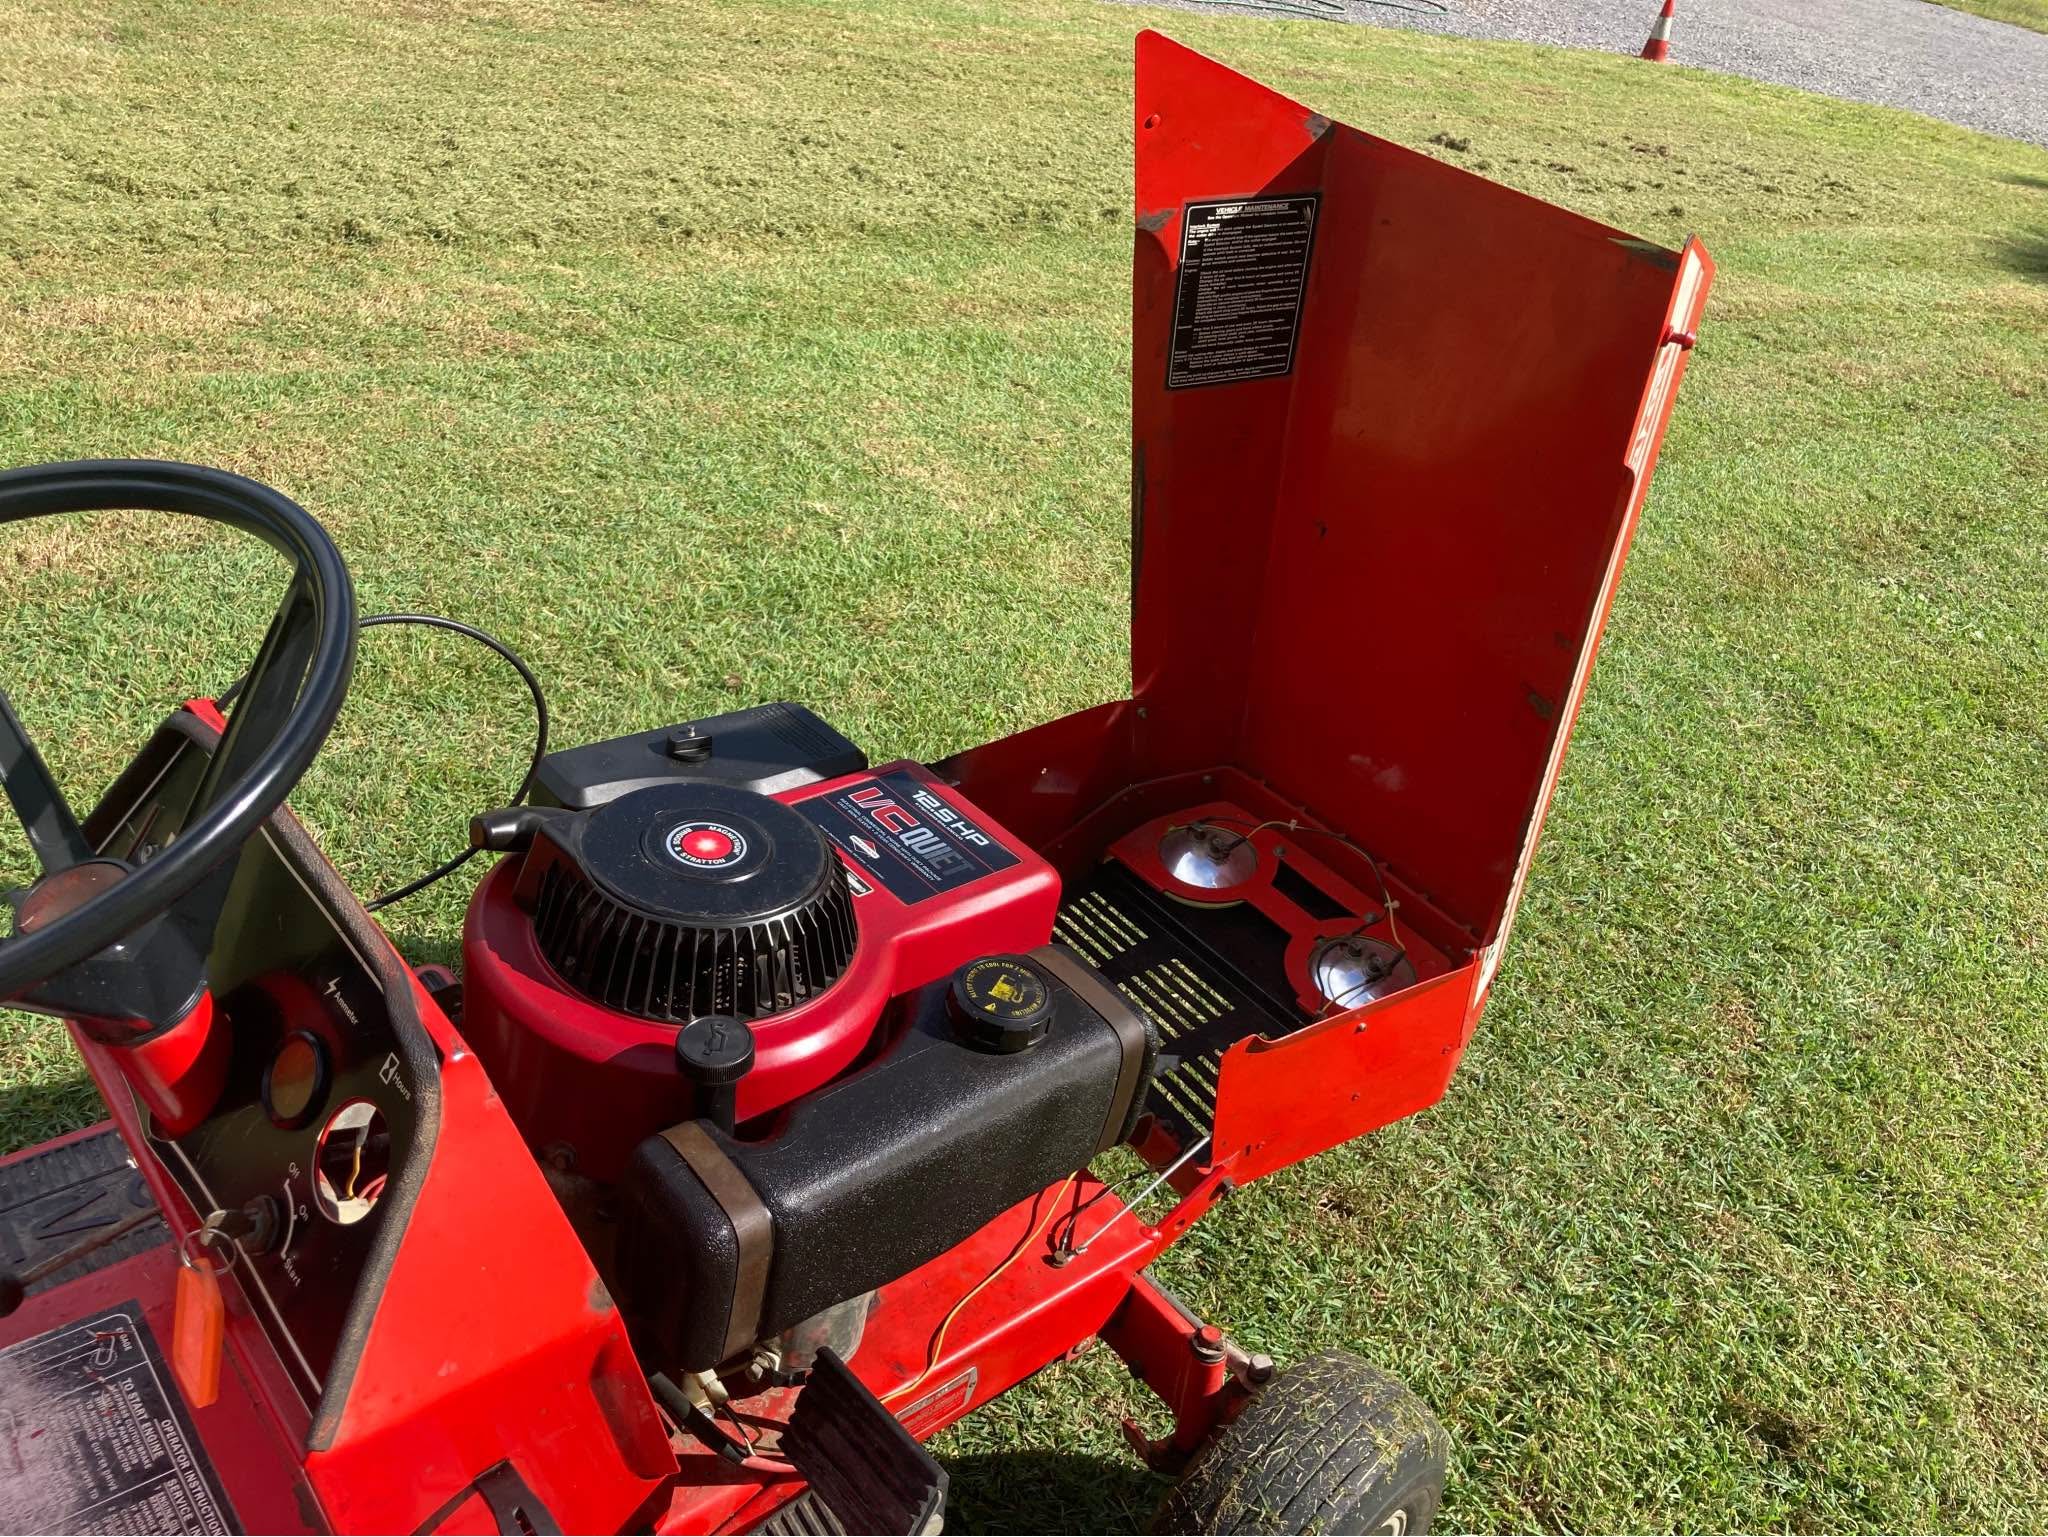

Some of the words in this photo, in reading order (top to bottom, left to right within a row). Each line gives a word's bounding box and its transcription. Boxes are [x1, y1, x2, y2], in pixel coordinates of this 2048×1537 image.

[1216, 206, 1243, 214] VEHICLE
[1244, 203, 1289, 212] MAINTENANCE
[912, 790, 958, 823] 12.5
[950, 821, 989, 846] HP
[680, 852, 726, 865] STRATTON
[899, 827, 976, 875] QUIET
[334, 991, 359, 1025] Ammeter
[393, 1072, 411, 1101] Hours
[289, 1162, 300, 1179] Off
[300, 1205, 309, 1221] On
[285, 1258, 301, 1287] Start
[121, 1378, 134, 1391] TO
[127, 1392, 148, 1421] START
[102, 1416, 116, 1437] SPEED
[111, 1438, 131, 1472] SELECTOR
[117, 1426, 130, 1443] PARK
[125, 1445, 138, 1464] KNOB
[123, 1418, 153, 1468] CLUTCH/BRAKE
[140, 1422, 164, 1458] ENGINE
[160, 1419, 190, 1468] OPERATOR
[102, 1469, 118, 1490] DRIVE
[138, 1500, 157, 1529] CHANGE
[157, 1492, 174, 1517] ENGINE
[170, 1519, 179, 1530] OIL
[166, 1478, 193, 1520] SERVICE
